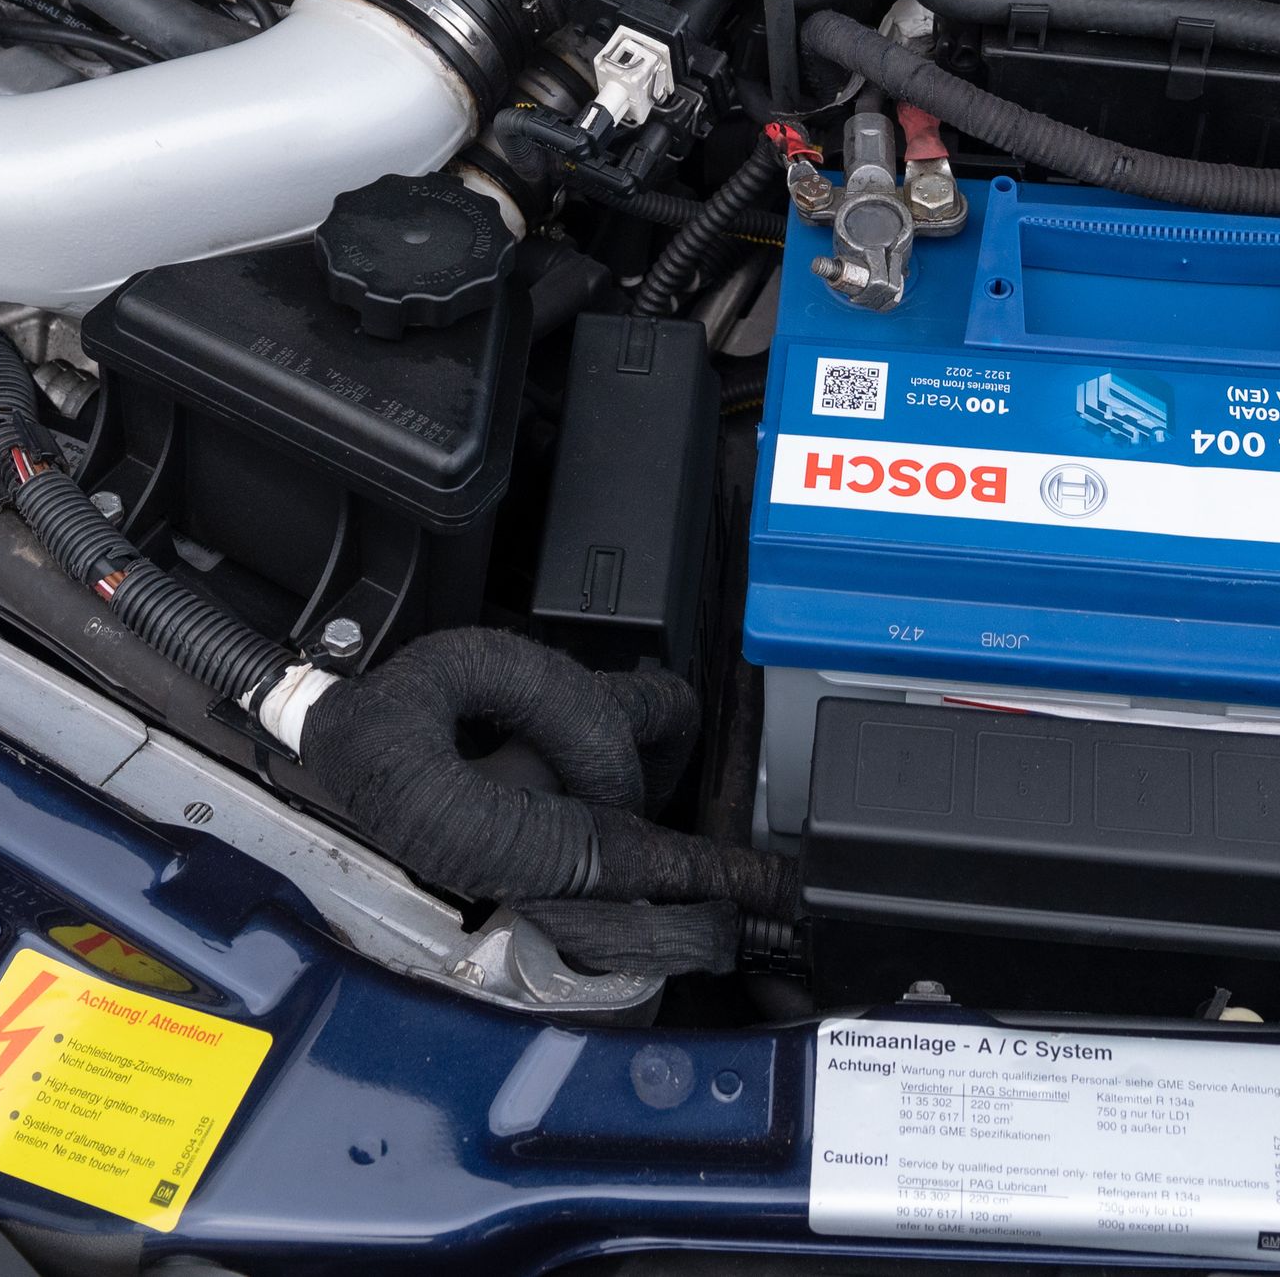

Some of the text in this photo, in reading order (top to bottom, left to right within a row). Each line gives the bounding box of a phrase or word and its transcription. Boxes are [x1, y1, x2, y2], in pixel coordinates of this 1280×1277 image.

[910, 376, 1010, 393] Batteries from Bosch
[945, 366, 1011, 381] 1922 2022
[905, 391, 1009, 415] 100 Years
[1226, 385, 1269, 403] (EN)
[1228, 405, 1280, 421] 60Ah
[1189, 427, 1266, 457] 004
[803, 452, 1007, 503] BOSCH
[887, 624, 1029, 649] JCMB 476
[76, 988, 223, 1047] Achtung! Attention!
[829, 1029, 1113, 1064] Klimaanlage A / C System
[58, 1052, 132, 1086] Nicht berühren!
[66, 1035, 193, 1090] Hochleistungs-Zündsystem
[827, 1058, 1280, 1096] Achtung! Wartung nur durch qualifiziertes siehe GME Service Anleitung
[35, 1090, 101, 1122] Do not touch!
[43, 1075, 175, 1129] High-energy ignition system
[900, 1081, 1194, 1107] Verdichter PAG Schmiermittel Kältemittel R 134a
[901, 1095, 1190, 1121] 11 35 302 220 750 g nur für LD1
[898, 1124, 1050, 1143] gemäß GME Spezifikationen
[899, 1109, 1186, 1135] 90 507 617 120 900 g außer LD1
[13, 1130, 129, 1178] tension Ne pas toucher!
[21, 1114, 63, 1139] Système
[117, 1147, 126, 1158] à
[126, 1151, 156, 1169] haute
[171, 1160, 185, 1177] 90
[193, 1114, 209, 1136] 316
[823, 1150, 1270, 1189] Caution! Service by qualified personnel refer to GME service instructions
[155, 1184, 174, 1201] GM
[897, 1175, 1200, 1202] Compressor PAG Lubricant Refrigerant 134a
[930, 1192, 949, 1201] 302
[896, 1207, 1189, 1233] 90 507 617 120 except LD1
[896, 1221, 1041, 1238] refer to GME specifications
